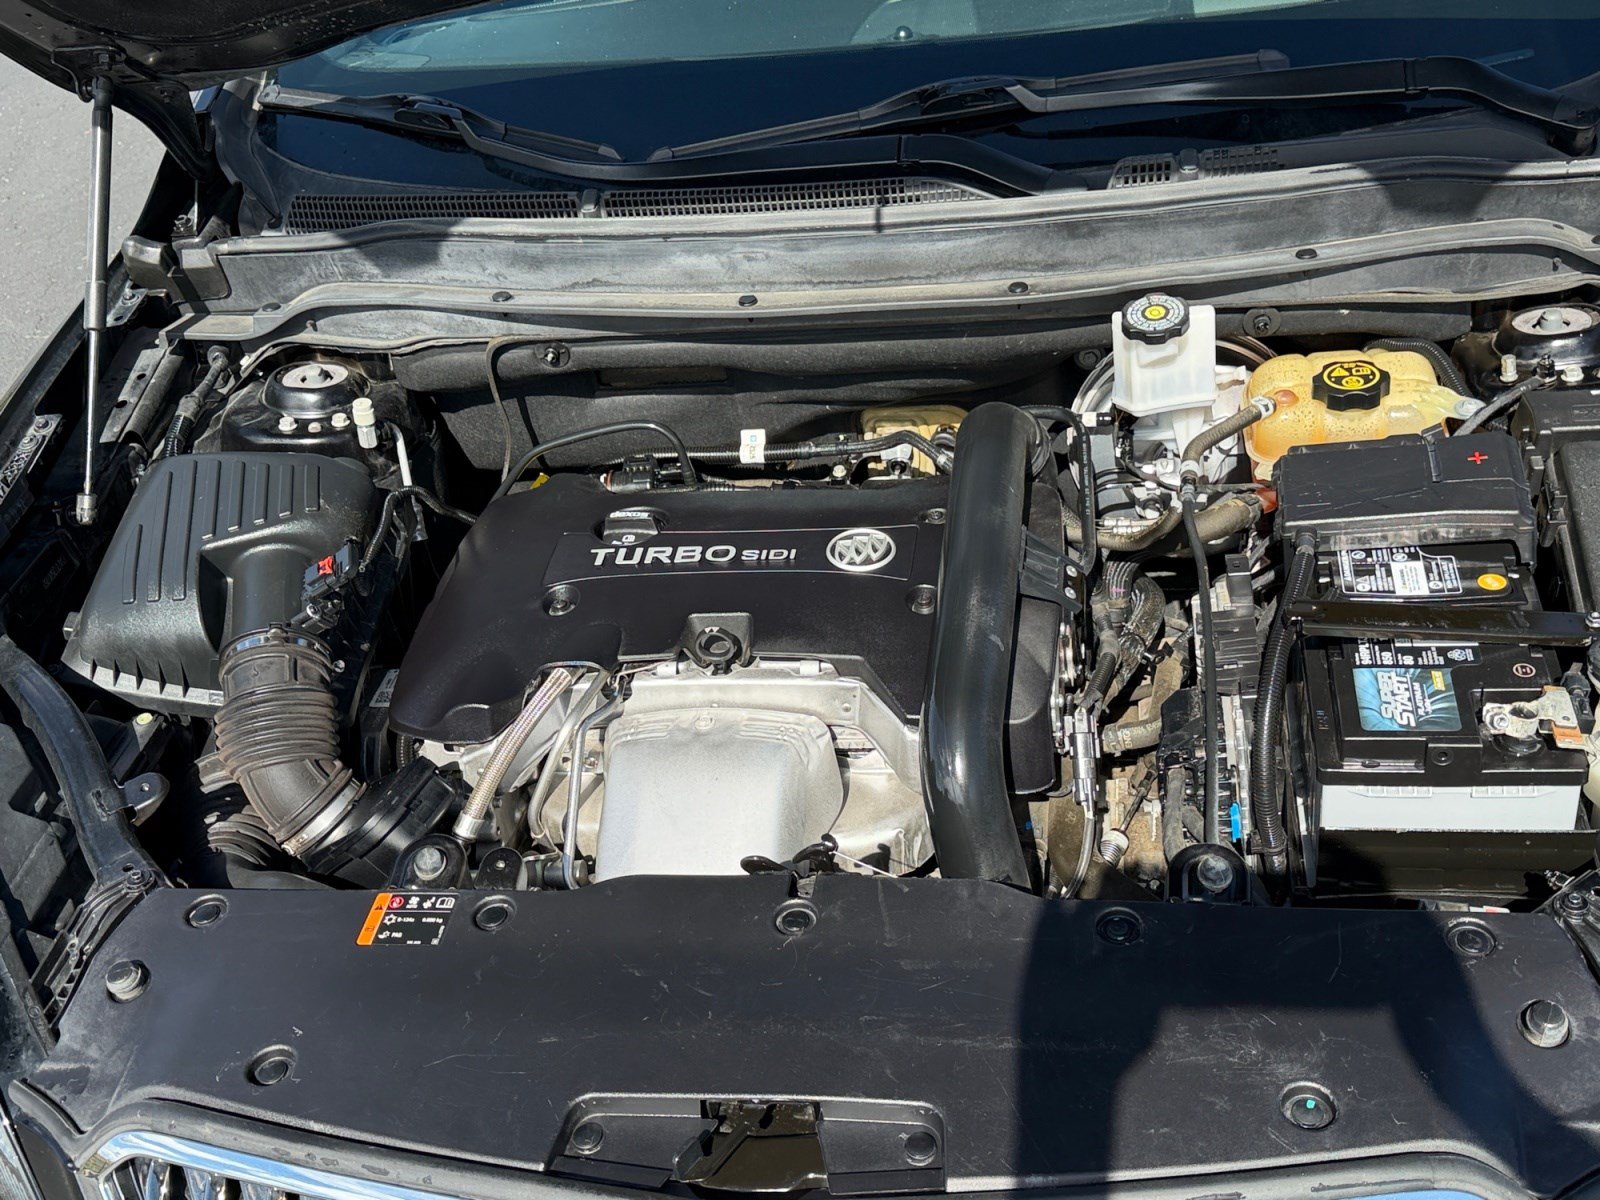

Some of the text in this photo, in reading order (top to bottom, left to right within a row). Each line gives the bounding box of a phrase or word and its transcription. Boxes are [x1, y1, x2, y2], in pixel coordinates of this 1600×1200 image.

[610, 511, 650, 519] dexos
[590, 545, 796, 566] TURBO SIDI
[1381, 651, 1394, 665] 850
[1402, 655, 1415, 665] 80
[1377, 671, 1394, 719] SUPER
[1390, 671, 1416, 727] START
[1412, 682, 1426, 716] PLATINUM
